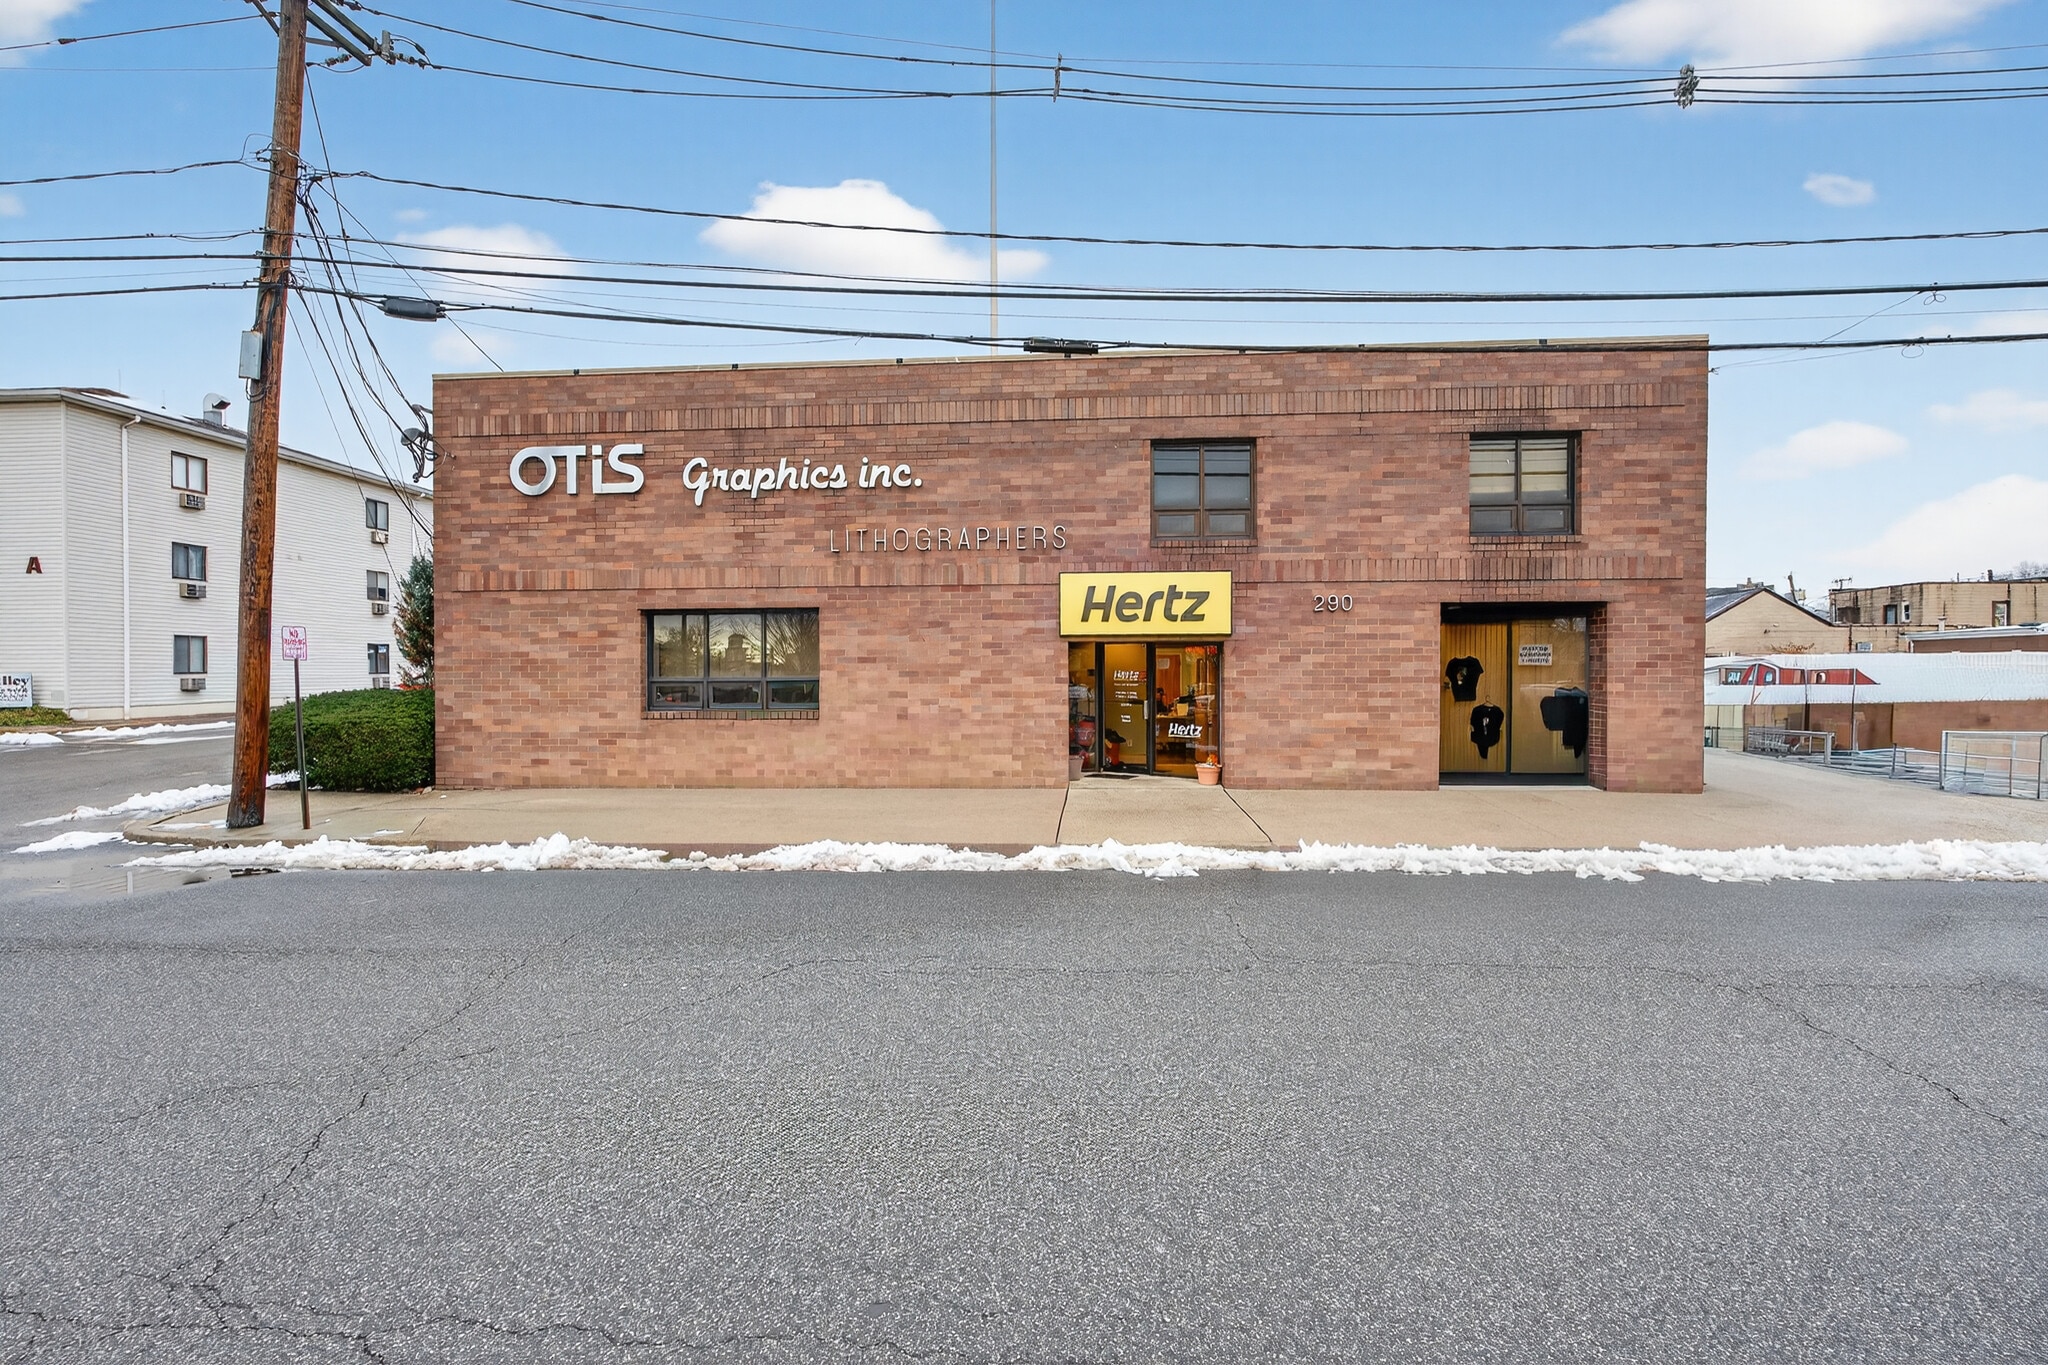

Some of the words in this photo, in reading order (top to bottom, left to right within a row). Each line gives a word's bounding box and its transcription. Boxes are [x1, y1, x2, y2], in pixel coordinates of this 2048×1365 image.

[682, 457, 848, 508] Graphics
[858, 456, 923, 489] inc.
[830, 525, 1067, 553] LITHOGRAPHERS
[26, 556, 42, 574] A
[1080, 584, 1210, 622] Hertz
[1313, 595, 1354, 613] 290
[1168, 722, 1203, 738] Hertz
